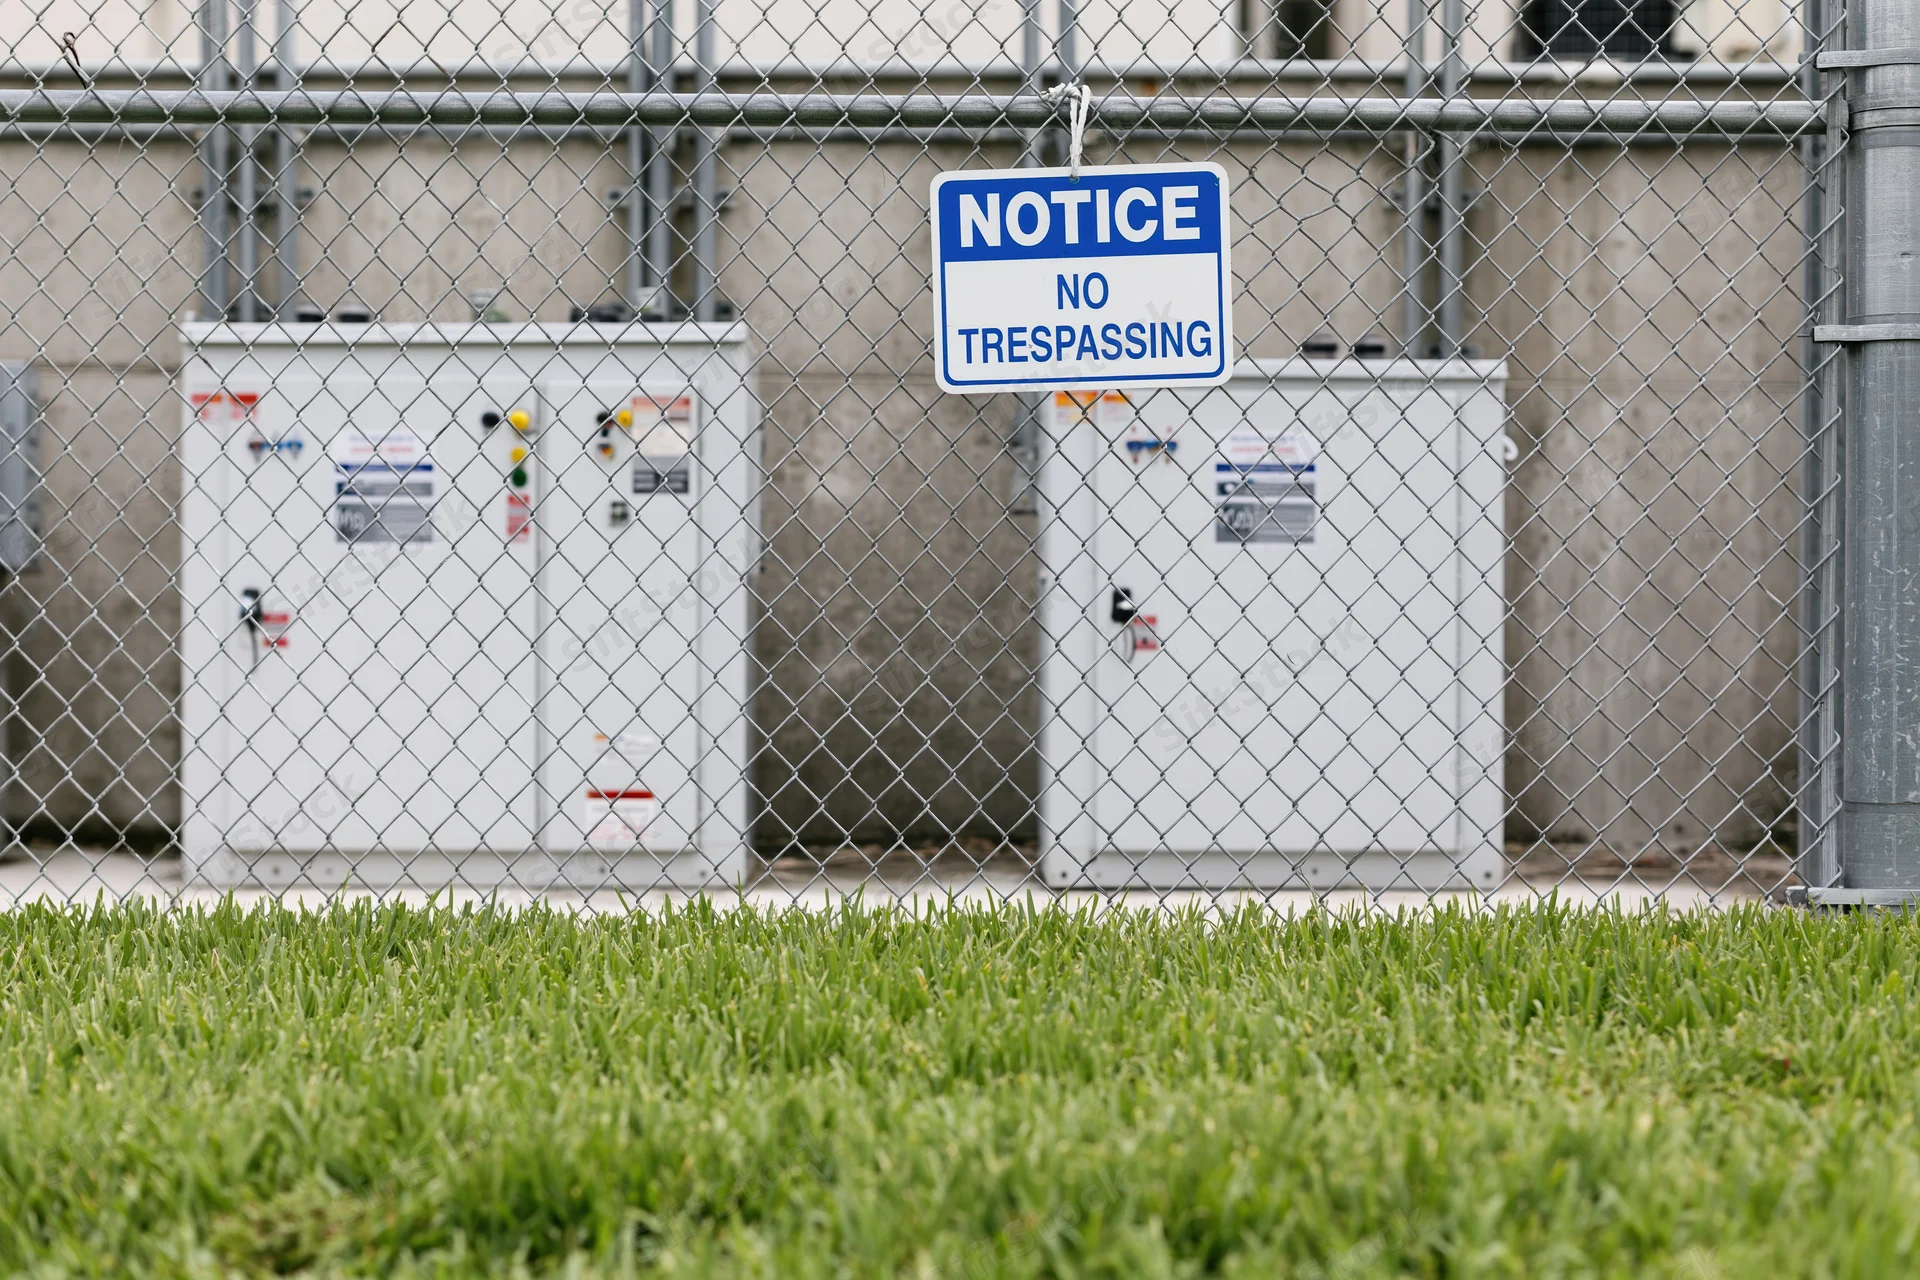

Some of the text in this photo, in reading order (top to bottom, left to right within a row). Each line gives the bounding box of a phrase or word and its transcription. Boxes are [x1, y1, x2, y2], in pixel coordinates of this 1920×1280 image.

[959, 186, 1200, 248] NOTICE
[1057, 272, 1109, 310] NO
[958, 320, 1212, 364] TRESPASSING
